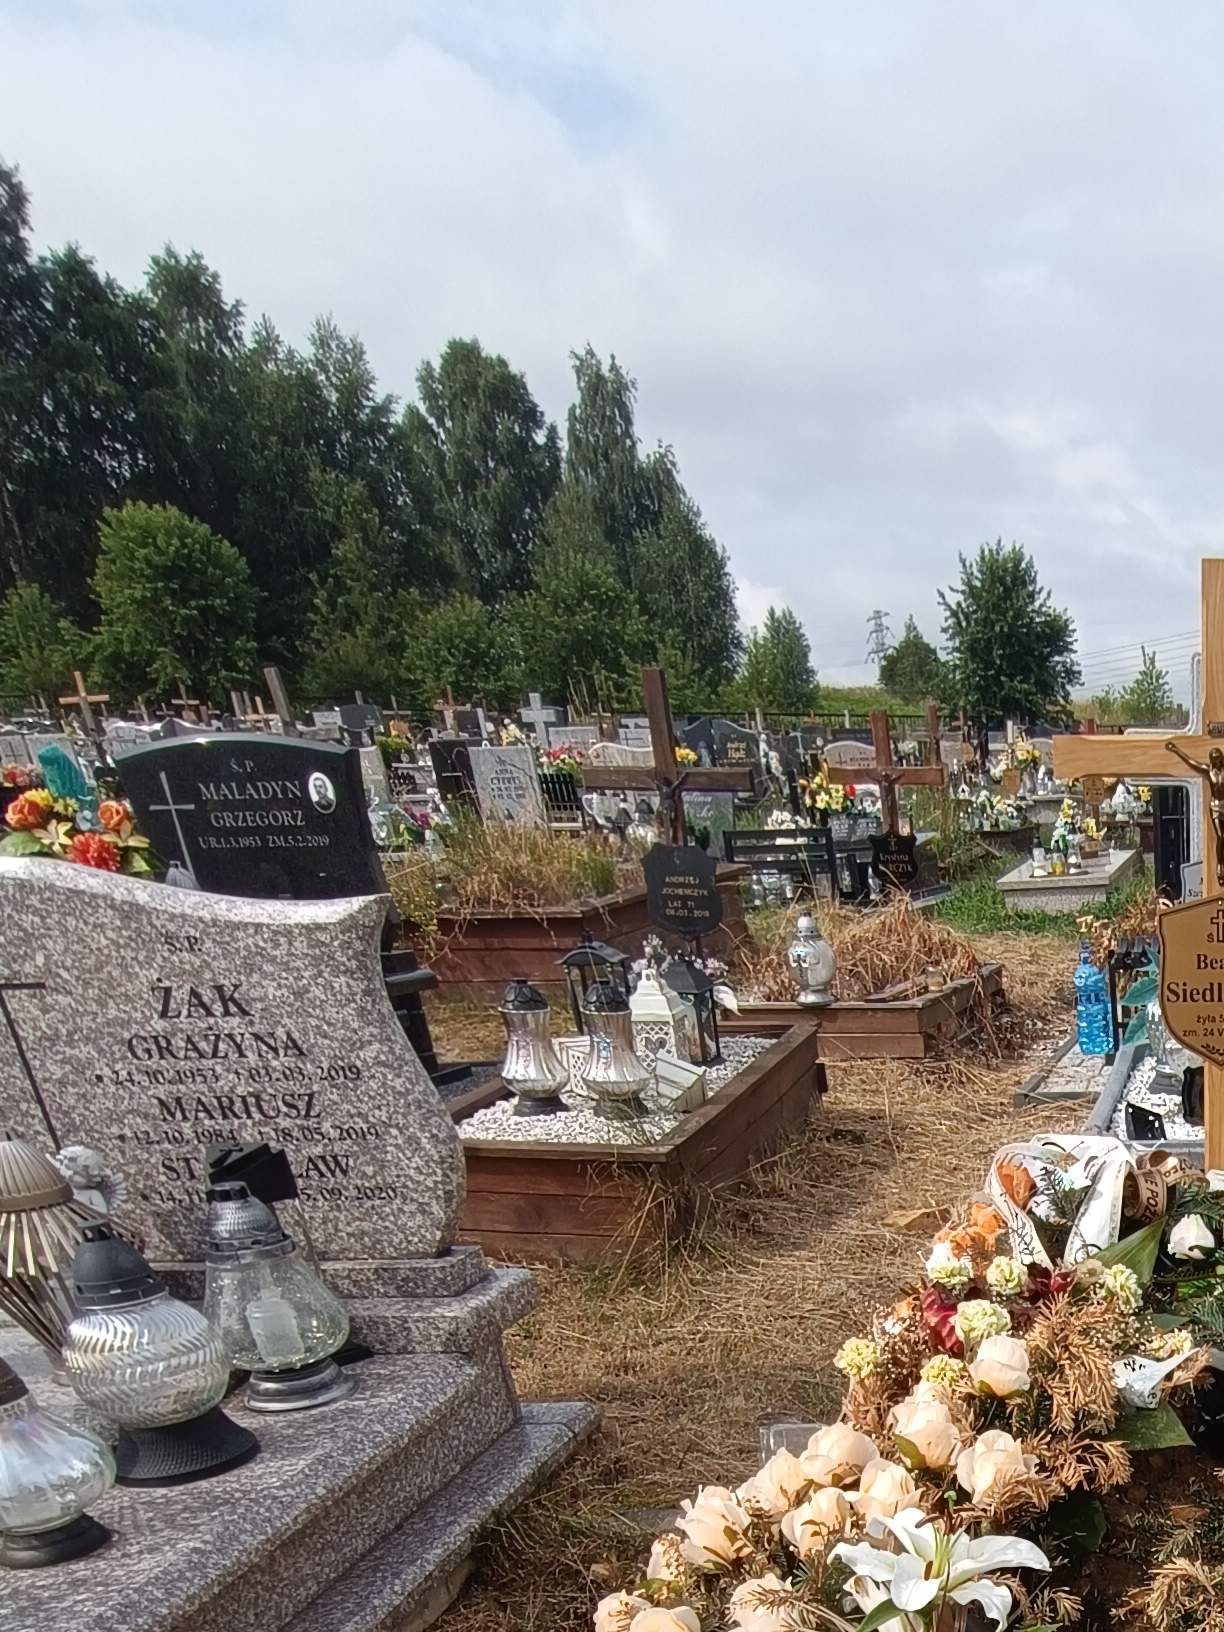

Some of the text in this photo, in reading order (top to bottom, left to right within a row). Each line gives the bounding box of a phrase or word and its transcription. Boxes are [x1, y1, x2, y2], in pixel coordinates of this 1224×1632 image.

[198, 781, 302, 800] MALADYN
[210, 810, 306, 827] GRZEGORZ
[151, 977, 254, 1019] ŻAK
[128, 1026, 307, 1061] GRAŻYNA
[1203, 1028, 1215, 1037] 24
[151, 1092, 321, 1121] MARIUSZ
